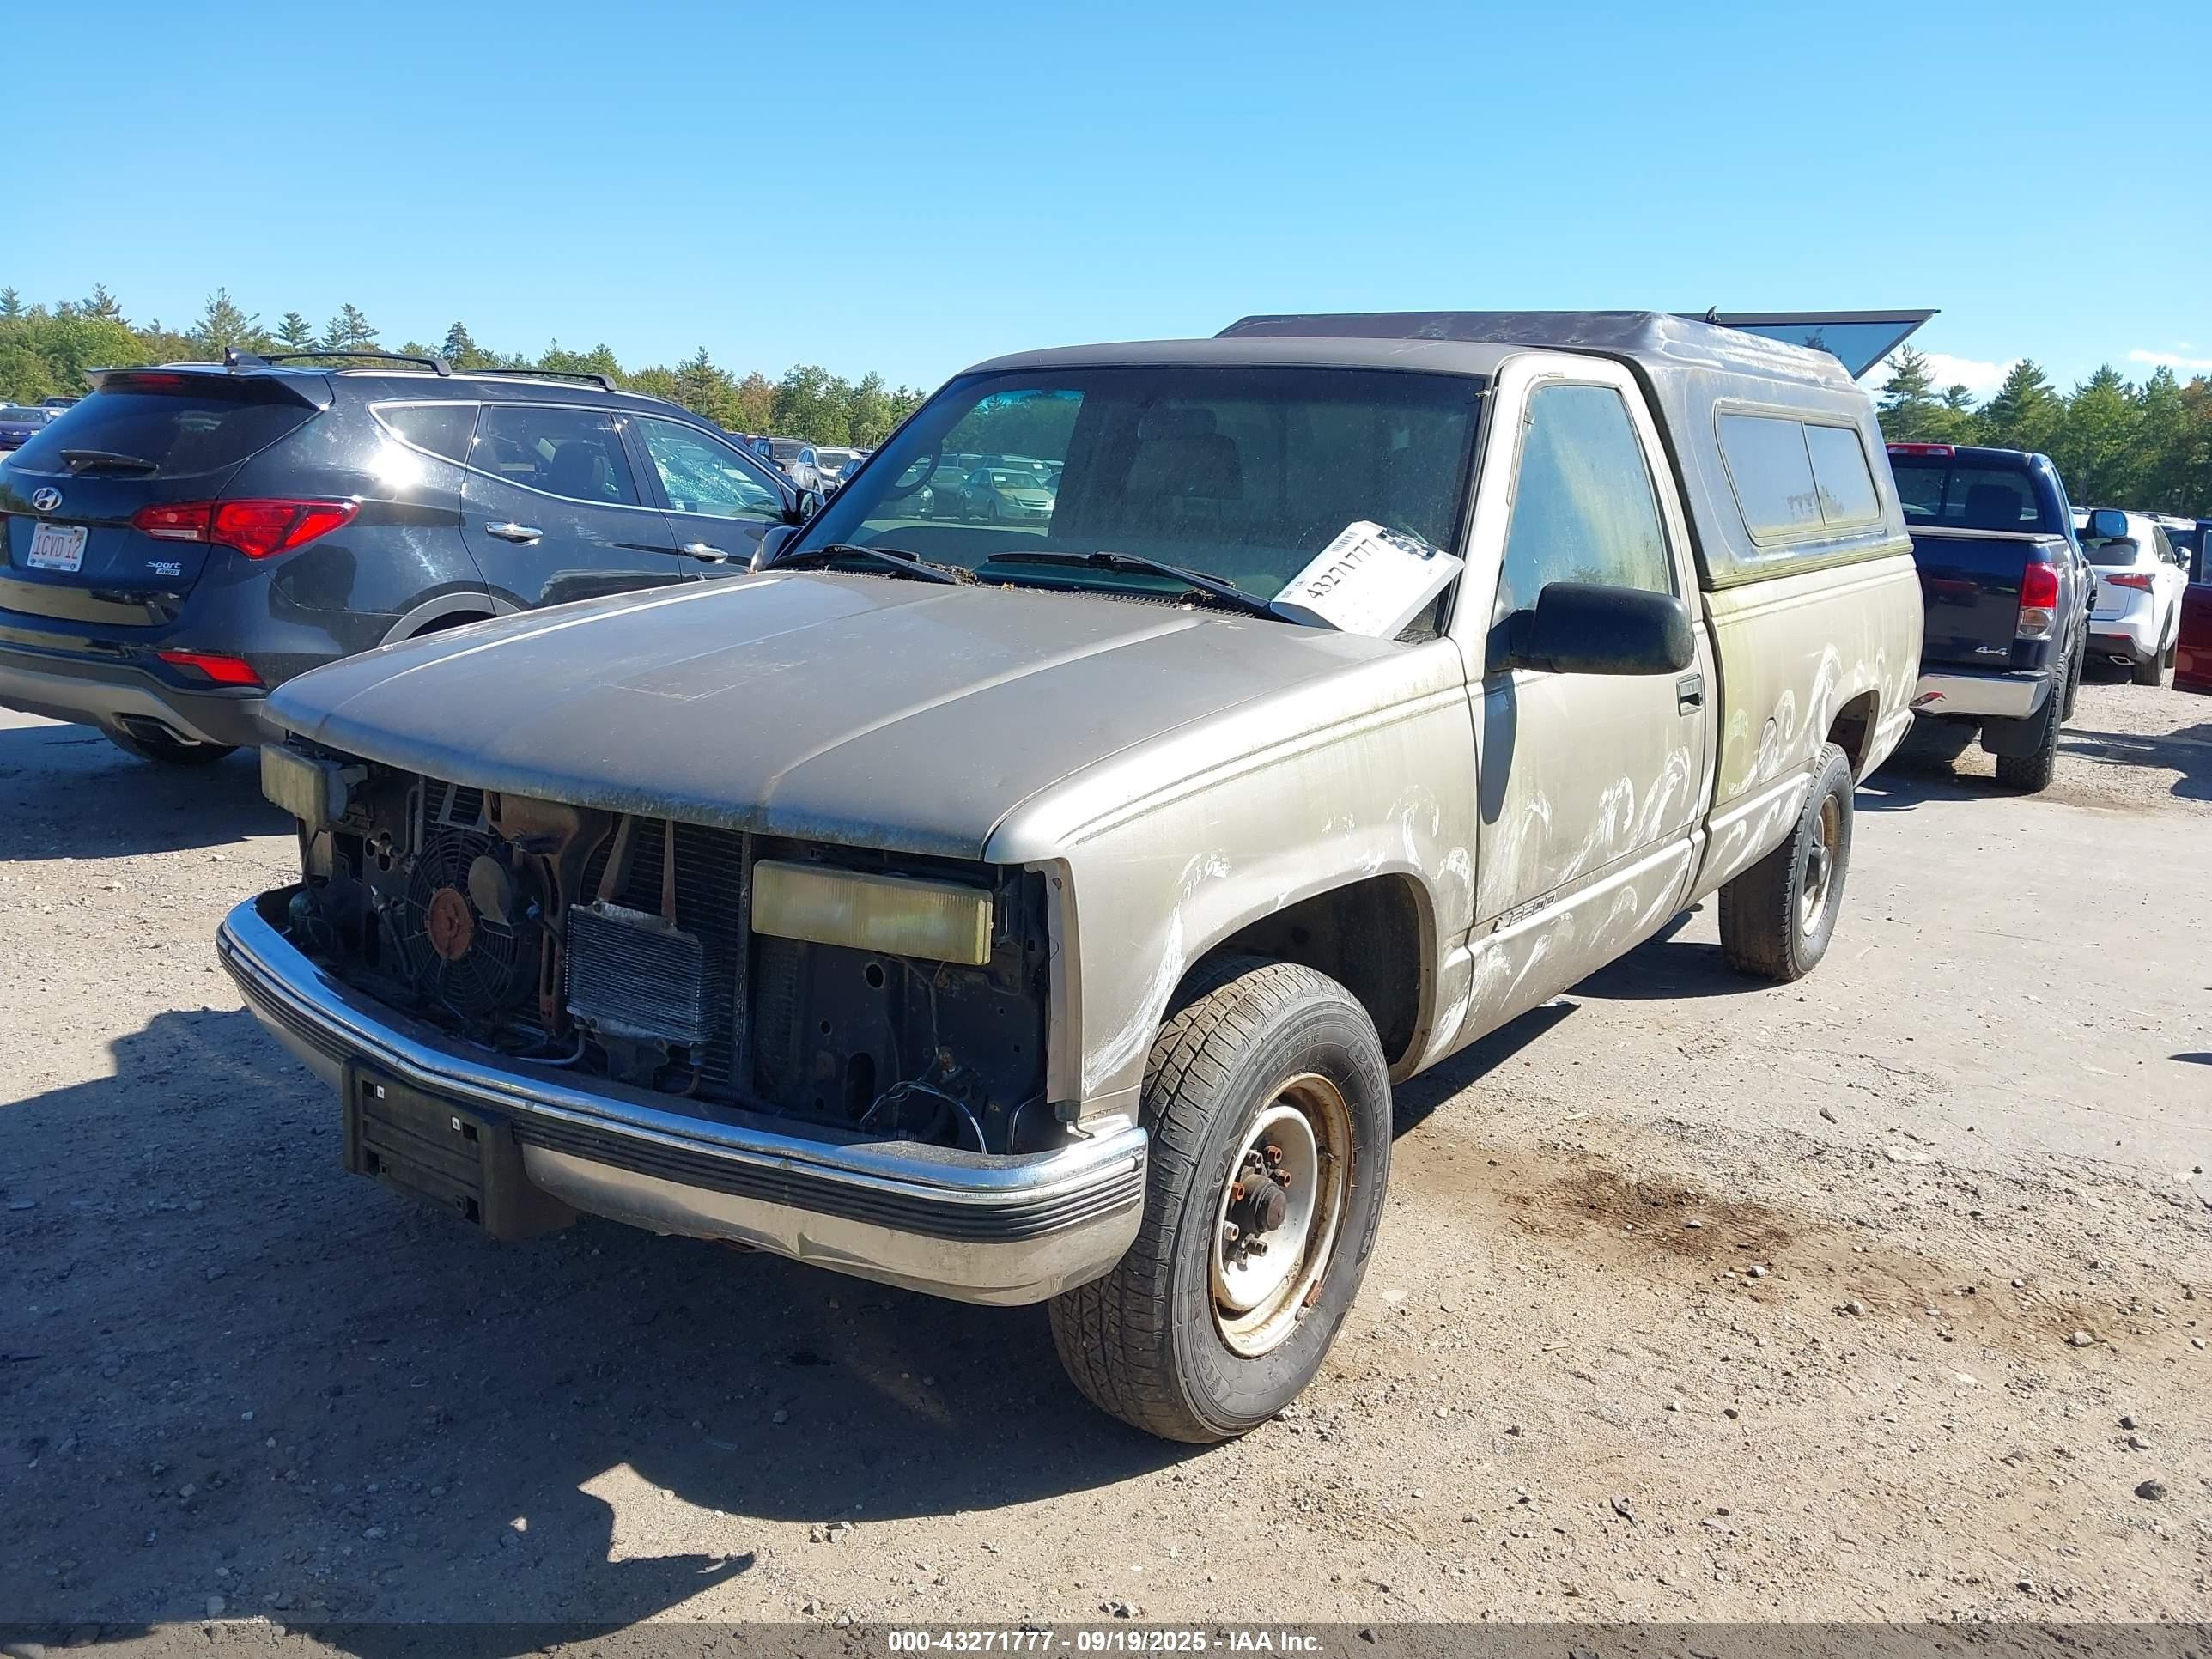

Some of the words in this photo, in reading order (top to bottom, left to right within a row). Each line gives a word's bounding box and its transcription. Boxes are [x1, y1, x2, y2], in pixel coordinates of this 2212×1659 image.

[145, 561, 182, 569] Sport
[1307, 538, 1380, 599] 43271777
[1353, 1042, 1386, 1255] DESTINATION
